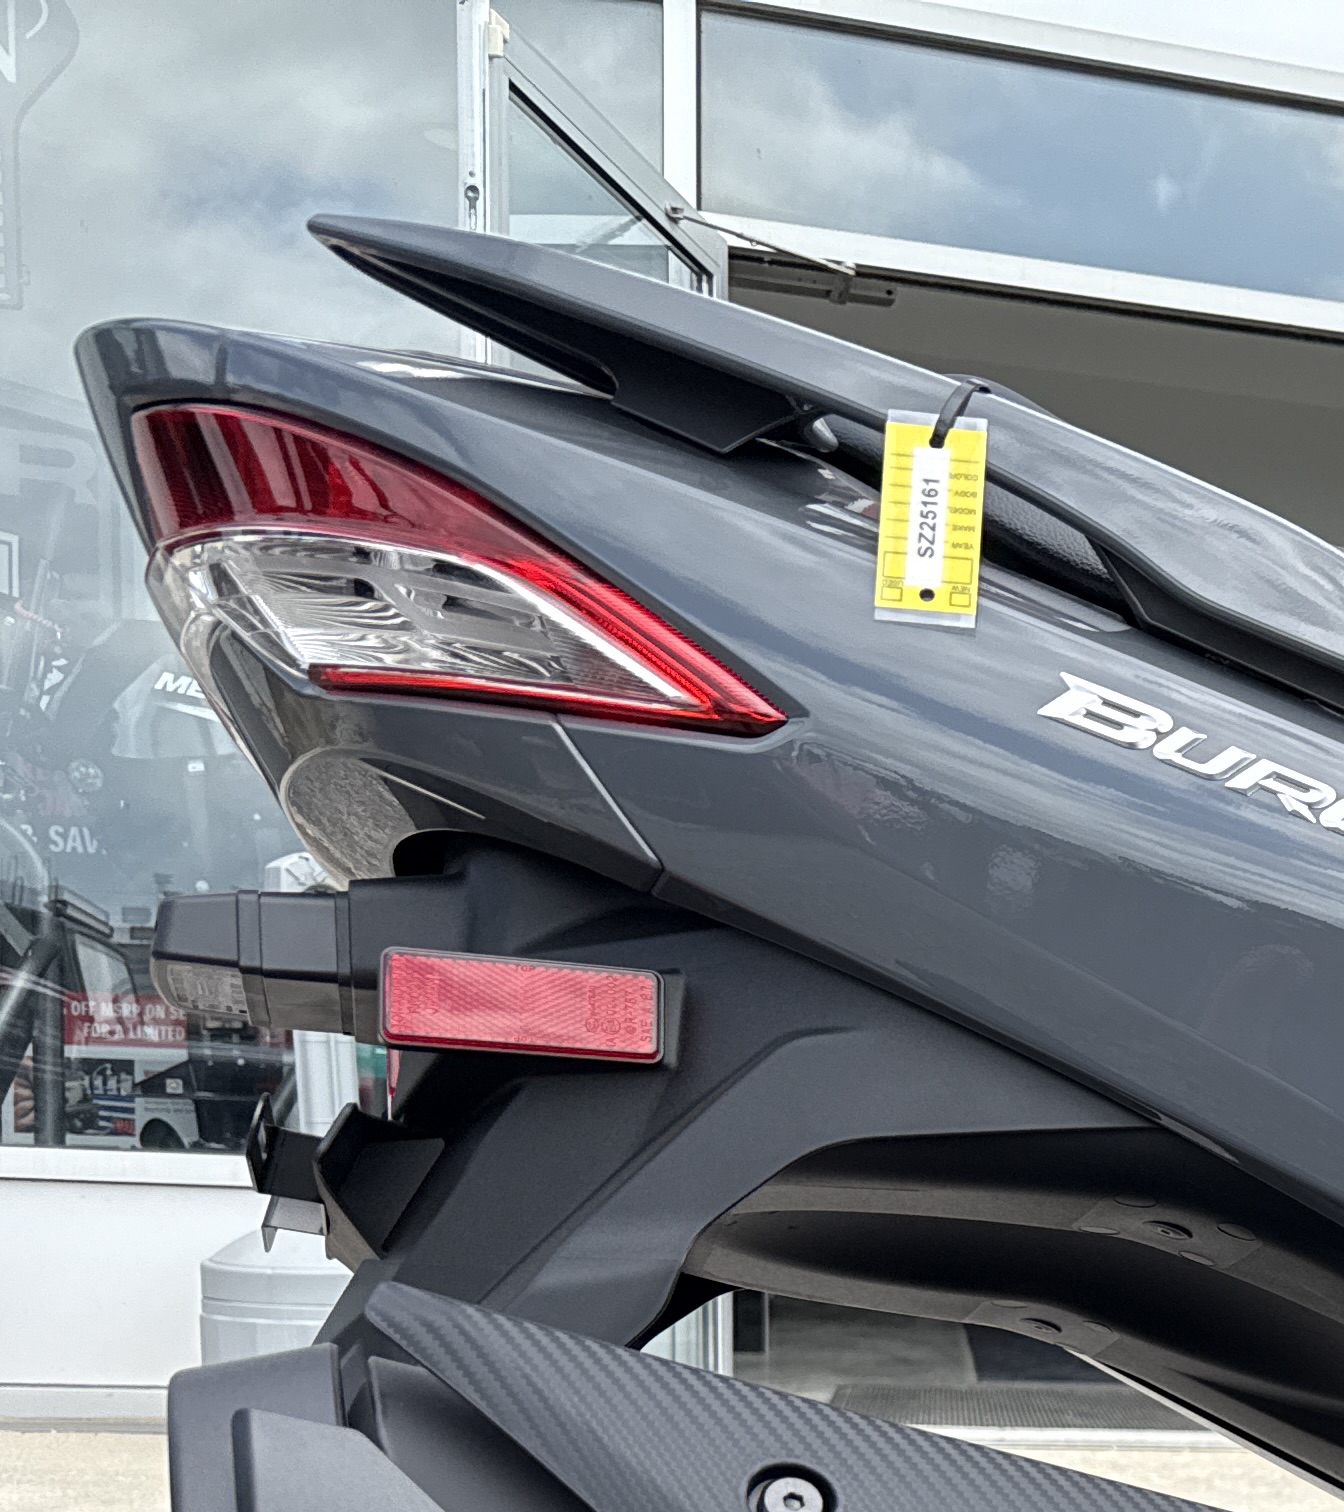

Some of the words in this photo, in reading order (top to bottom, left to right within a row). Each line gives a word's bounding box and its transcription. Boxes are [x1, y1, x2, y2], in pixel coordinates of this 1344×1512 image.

[917, 477, 941, 559] SZ25161
[71, 1001, 97, 1017] OFF
[145, 1004, 166, 1019] ON
[83, 1022, 109, 1038] FOR
[129, 1024, 185, 1040] LIMITED
